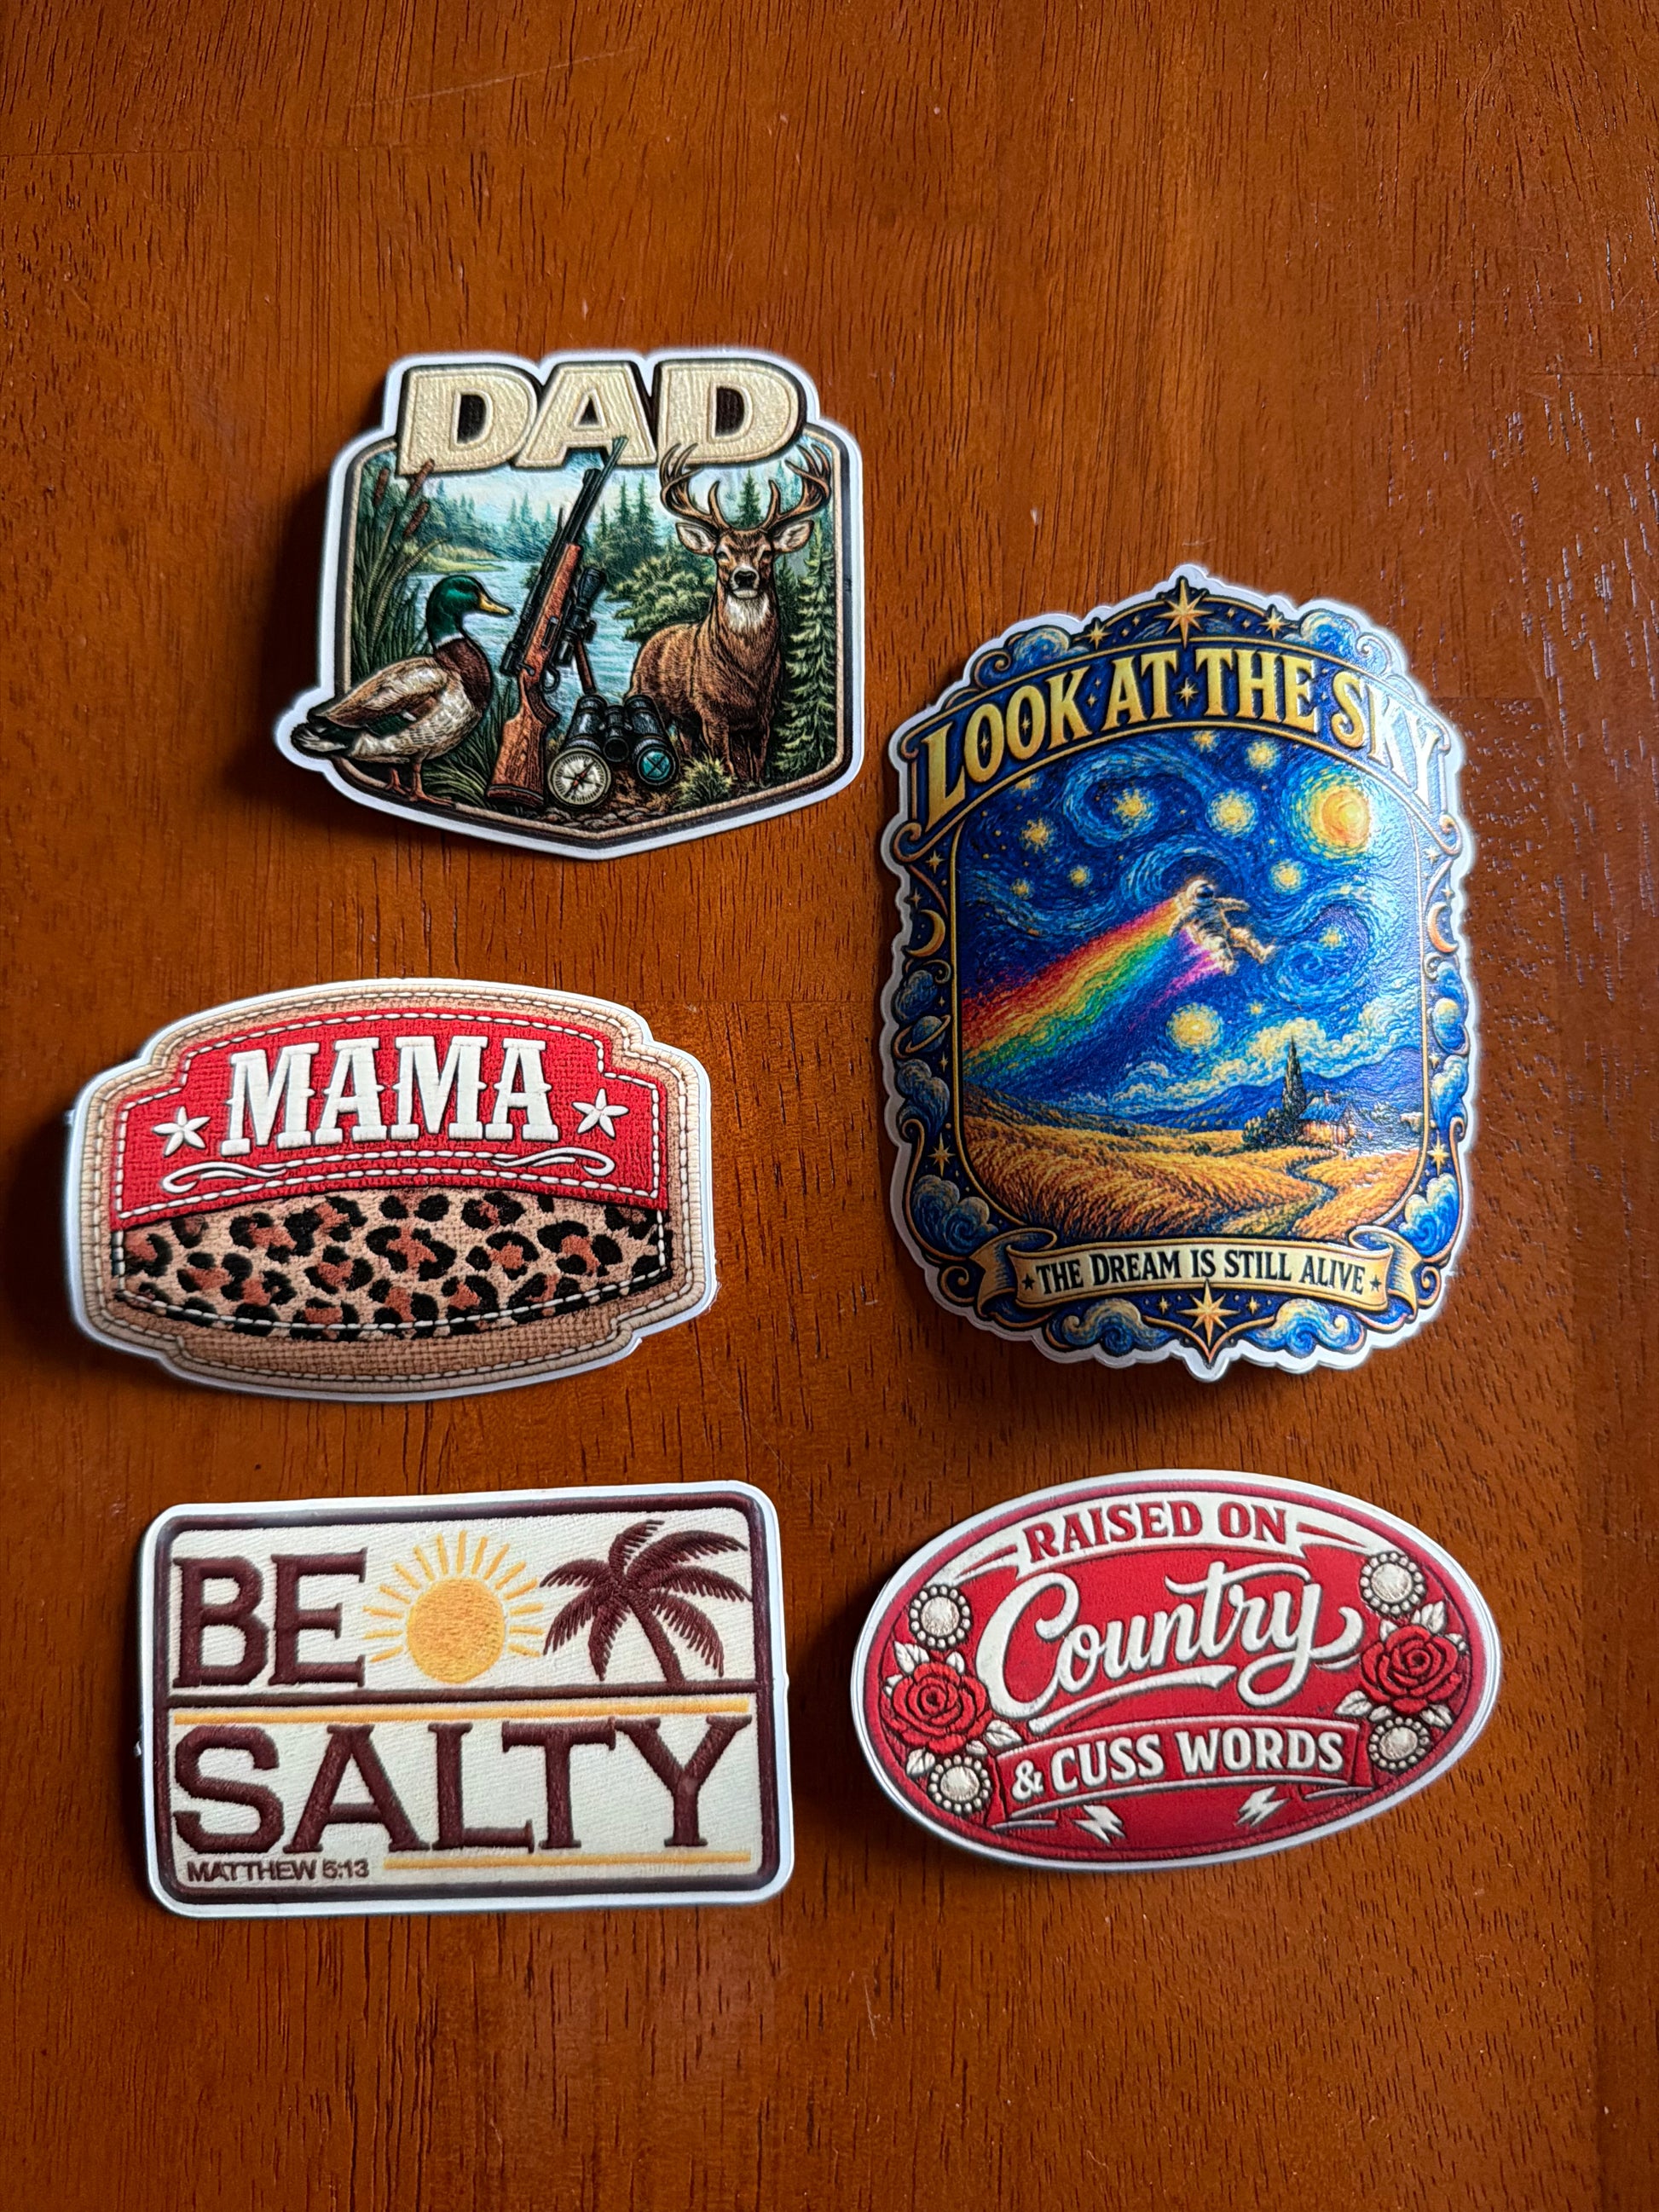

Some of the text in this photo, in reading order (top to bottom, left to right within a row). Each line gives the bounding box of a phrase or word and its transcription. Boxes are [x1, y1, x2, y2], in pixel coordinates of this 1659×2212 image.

[398, 360, 803, 476] DAD
[921, 647, 1441, 830] LOOK AT THE SKY
[220, 1036, 559, 1156] MAMA
[1036, 1249, 1364, 1294] THE DREAM IS STILL ALIVE
[1023, 1500, 1287, 1563] RAISED ON
[172, 1547, 367, 1688] BE
[975, 1561, 1364, 1719] Country
[172, 1714, 752, 1855] SALTY
[1011, 1728, 1344, 1802] & CUSS WORDS
[187, 1857, 370, 1882] MATTHEW 5:13
